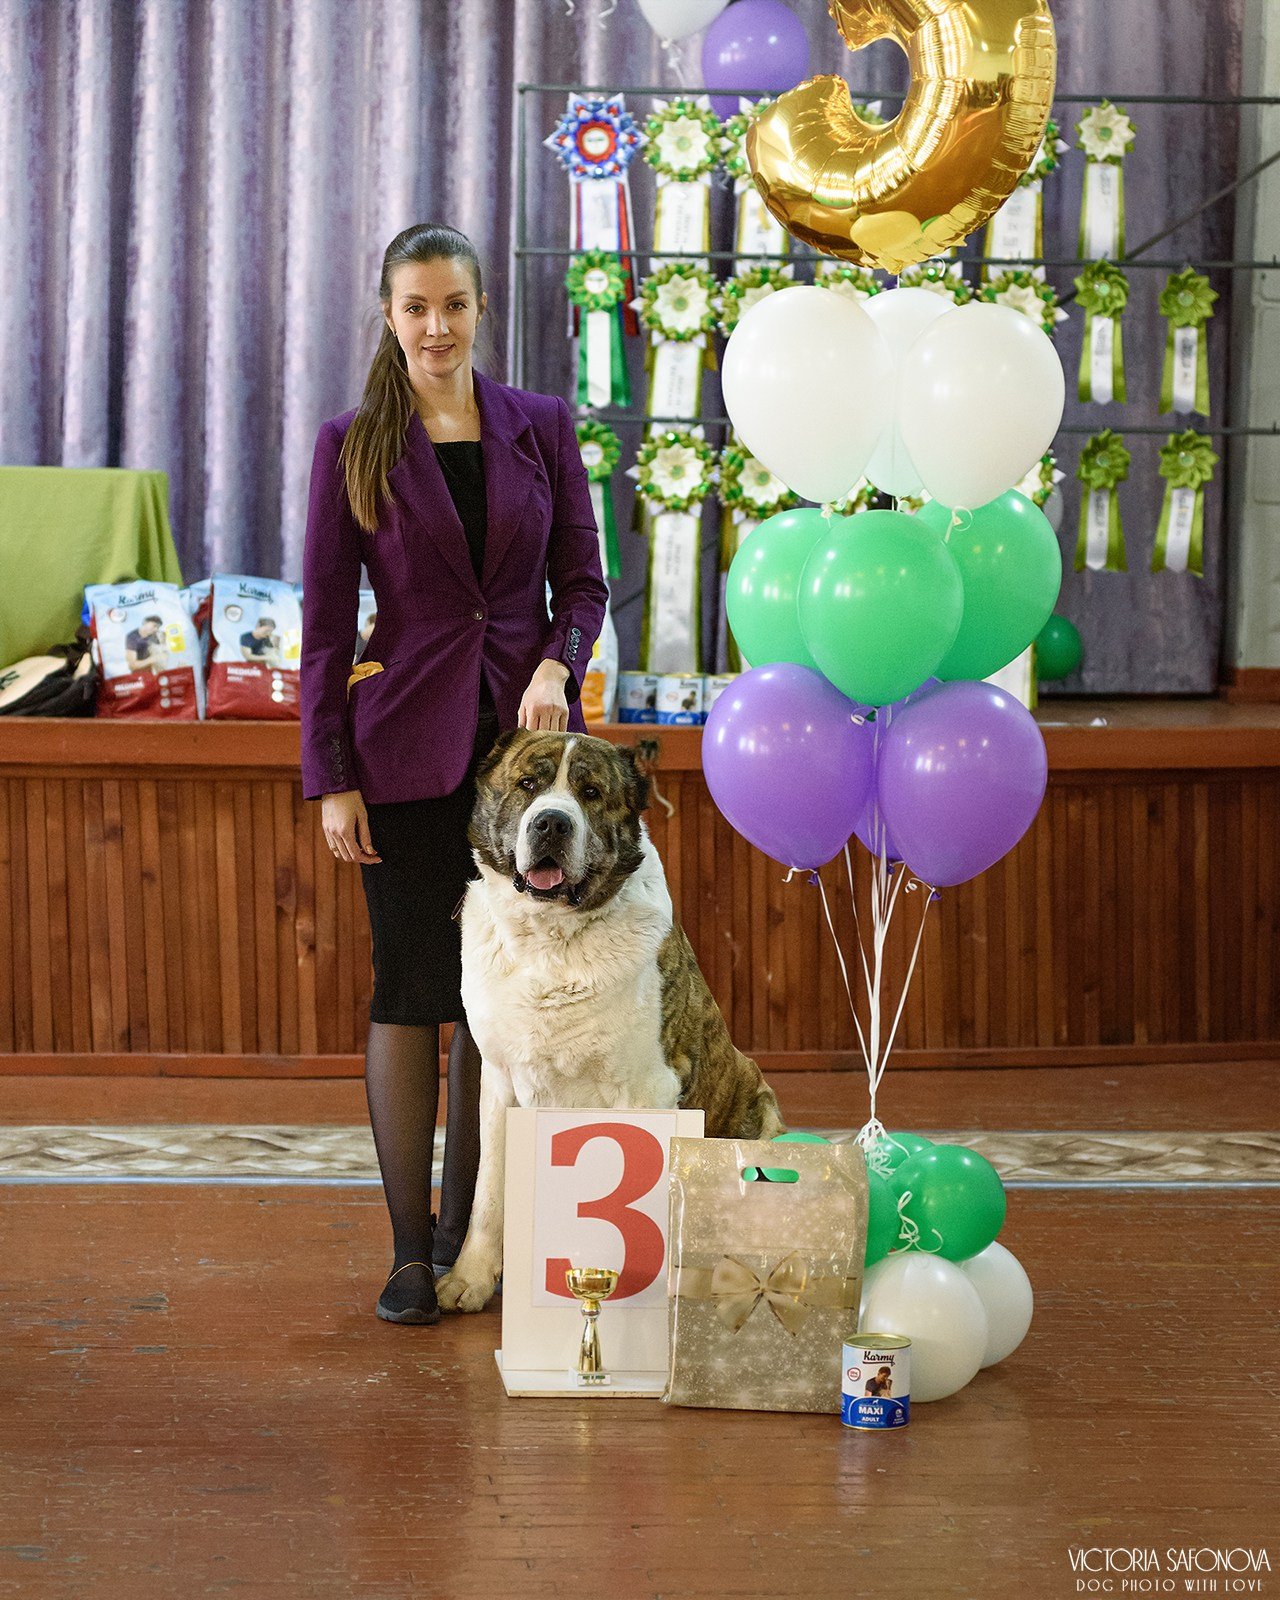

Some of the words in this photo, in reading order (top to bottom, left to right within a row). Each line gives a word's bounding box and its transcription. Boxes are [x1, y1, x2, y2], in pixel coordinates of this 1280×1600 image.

[545, 1122, 666, 1302] 3
[863, 1350, 895, 1366] Karmy
[858, 1406, 883, 1415] MAXI
